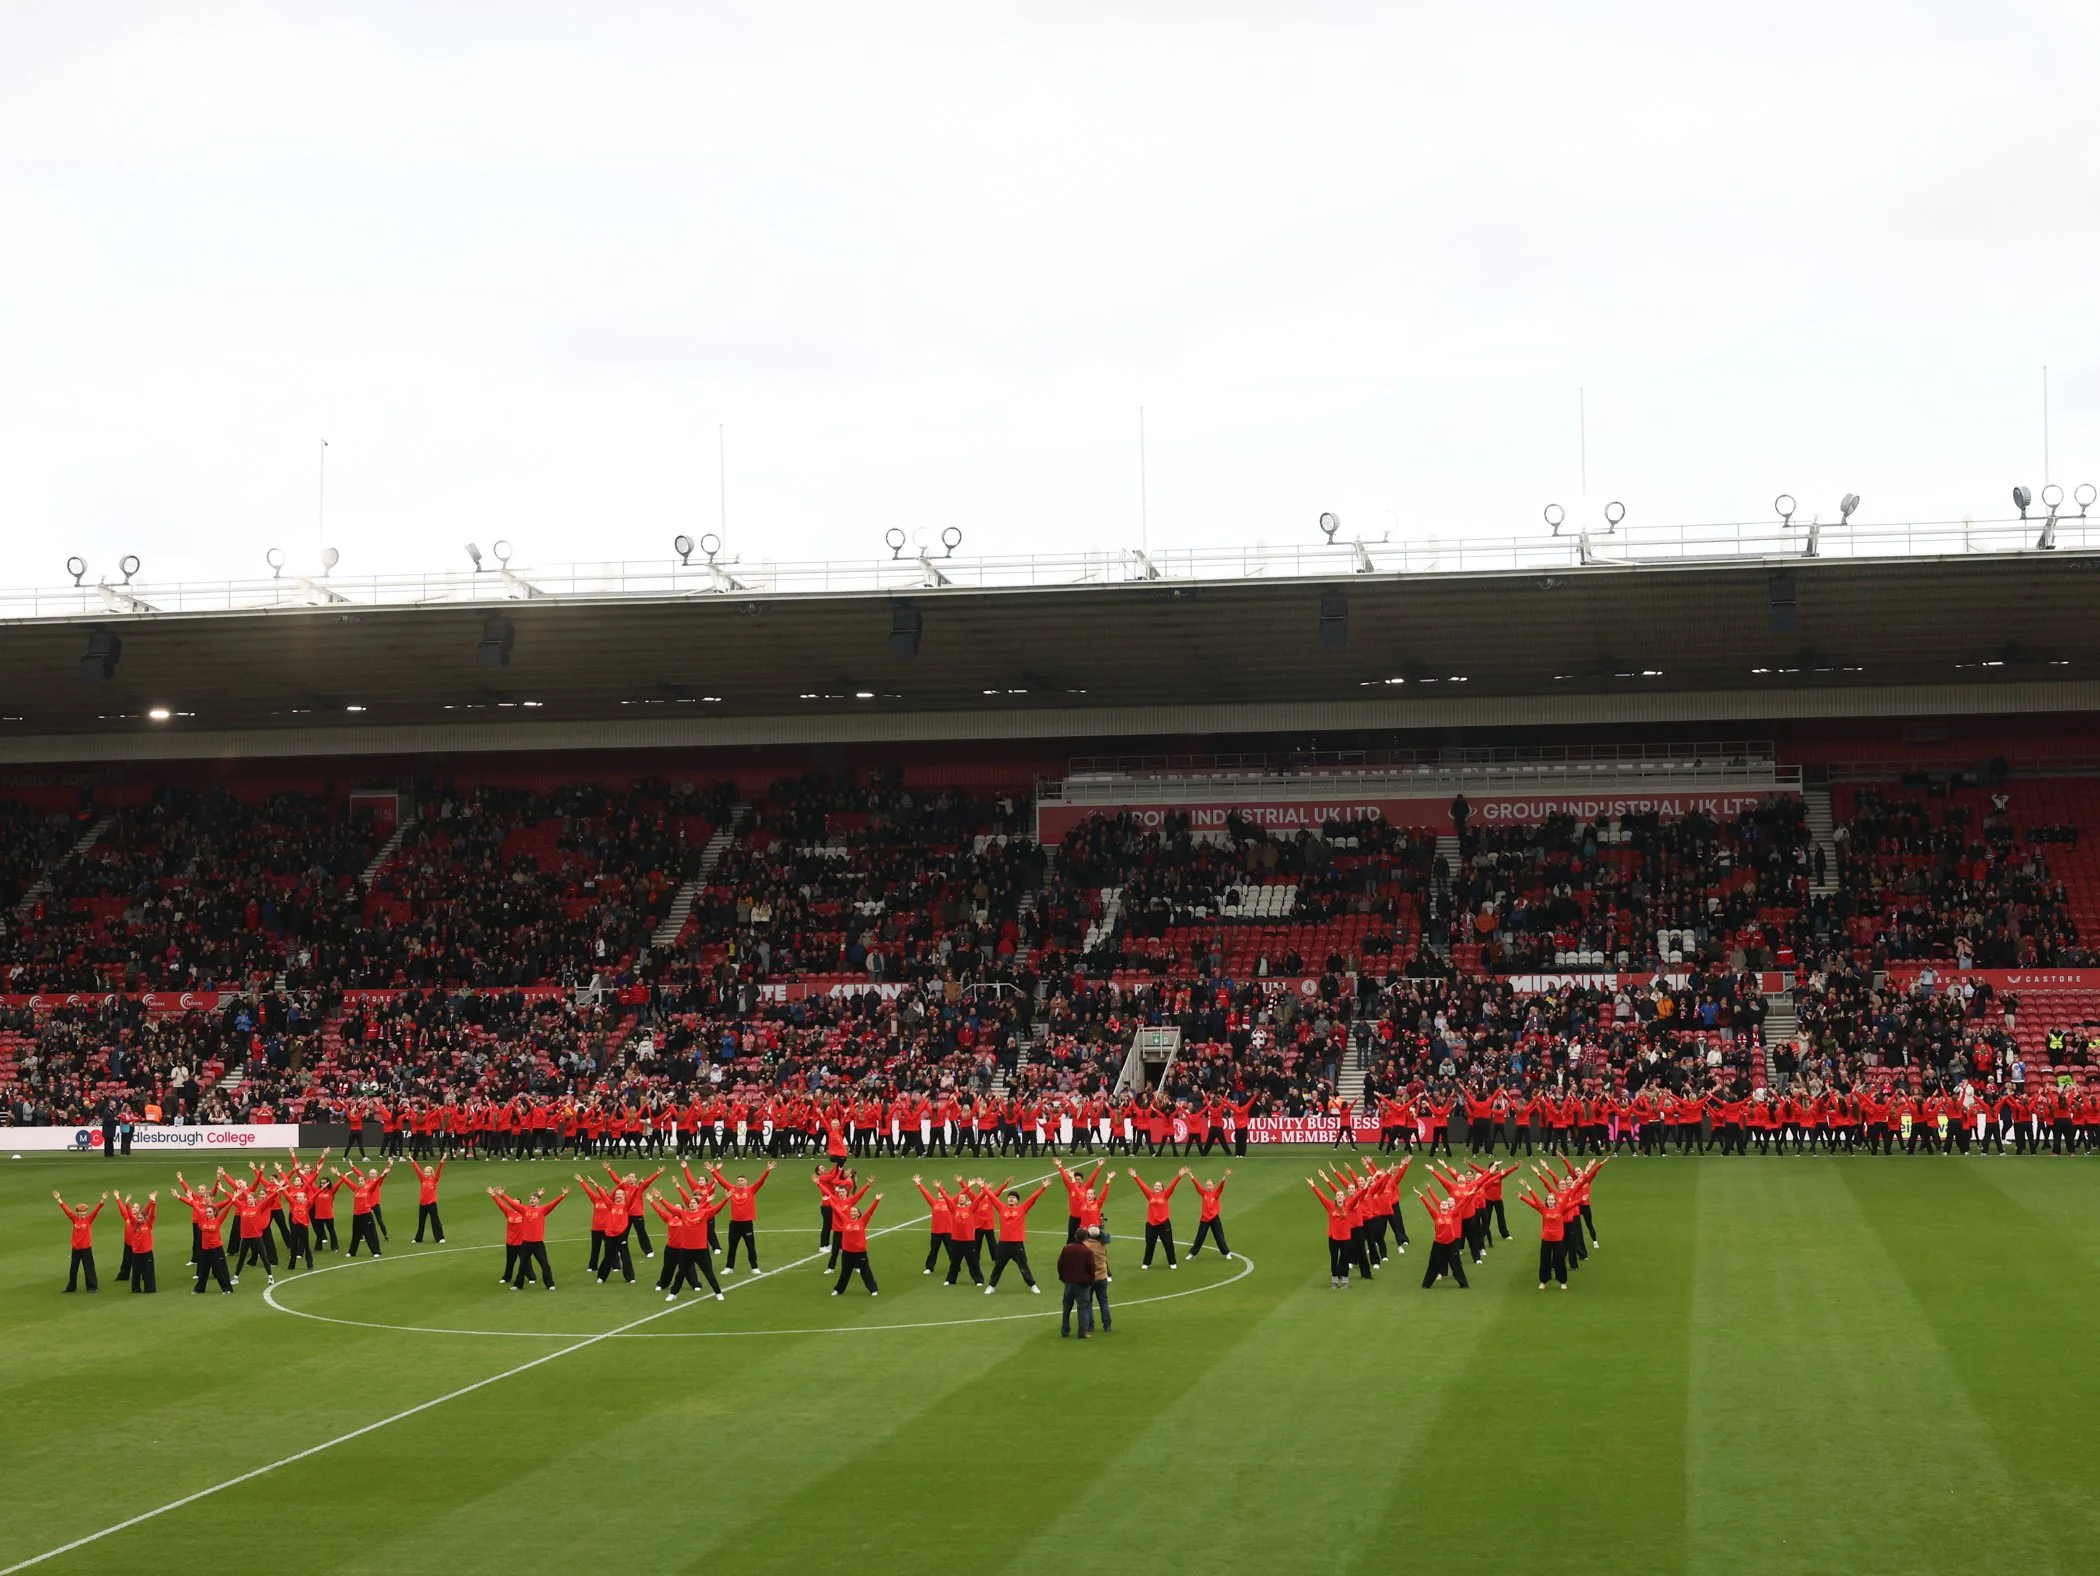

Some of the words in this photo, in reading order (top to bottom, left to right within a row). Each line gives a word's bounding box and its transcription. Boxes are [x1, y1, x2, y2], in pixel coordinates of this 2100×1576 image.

[1192, 807, 1309, 825] INDSTRIAL
[1314, 807, 1341, 823] UK
[1483, 802, 1557, 819] GROUP
[1562, 800, 1685, 818] INDUSTRIAL
[1307, 1117, 1380, 1130] BUSIESS
[207, 1131, 255, 1146] College
[1231, 1131, 1278, 1143] CUB+
